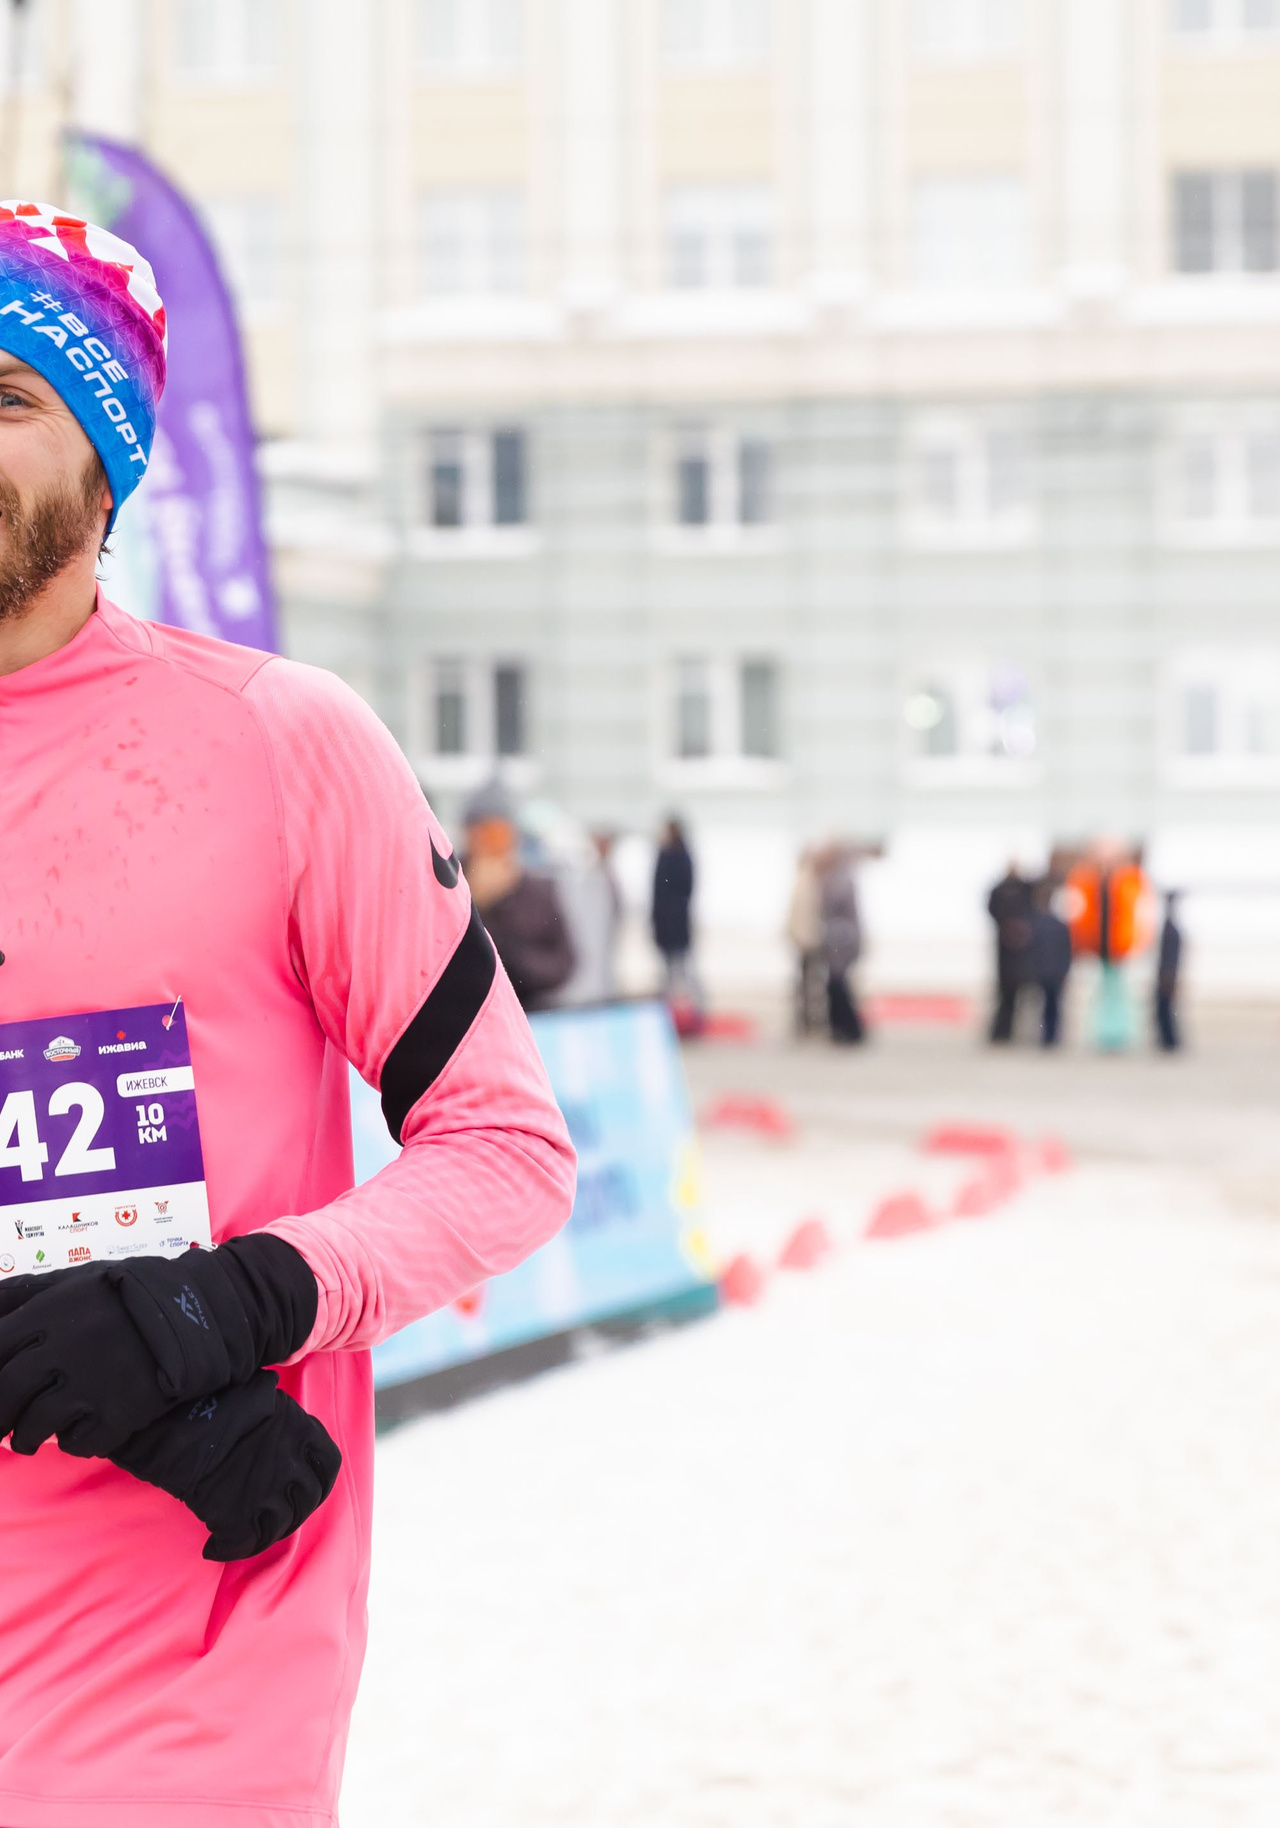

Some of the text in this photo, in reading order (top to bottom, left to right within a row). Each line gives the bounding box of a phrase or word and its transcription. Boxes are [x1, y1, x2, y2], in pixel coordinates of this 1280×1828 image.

[126, 1076, 168, 1091] ИЖЕВСК
[136, 1103, 165, 1127] 10
[138, 1125, 167, 1144] КМ
[58, 1221, 99, 1231] КАЛАШНИКОВ
[169, 1240, 189, 1248] СПОРТА
[68, 1246, 91, 1257] ПАПА
